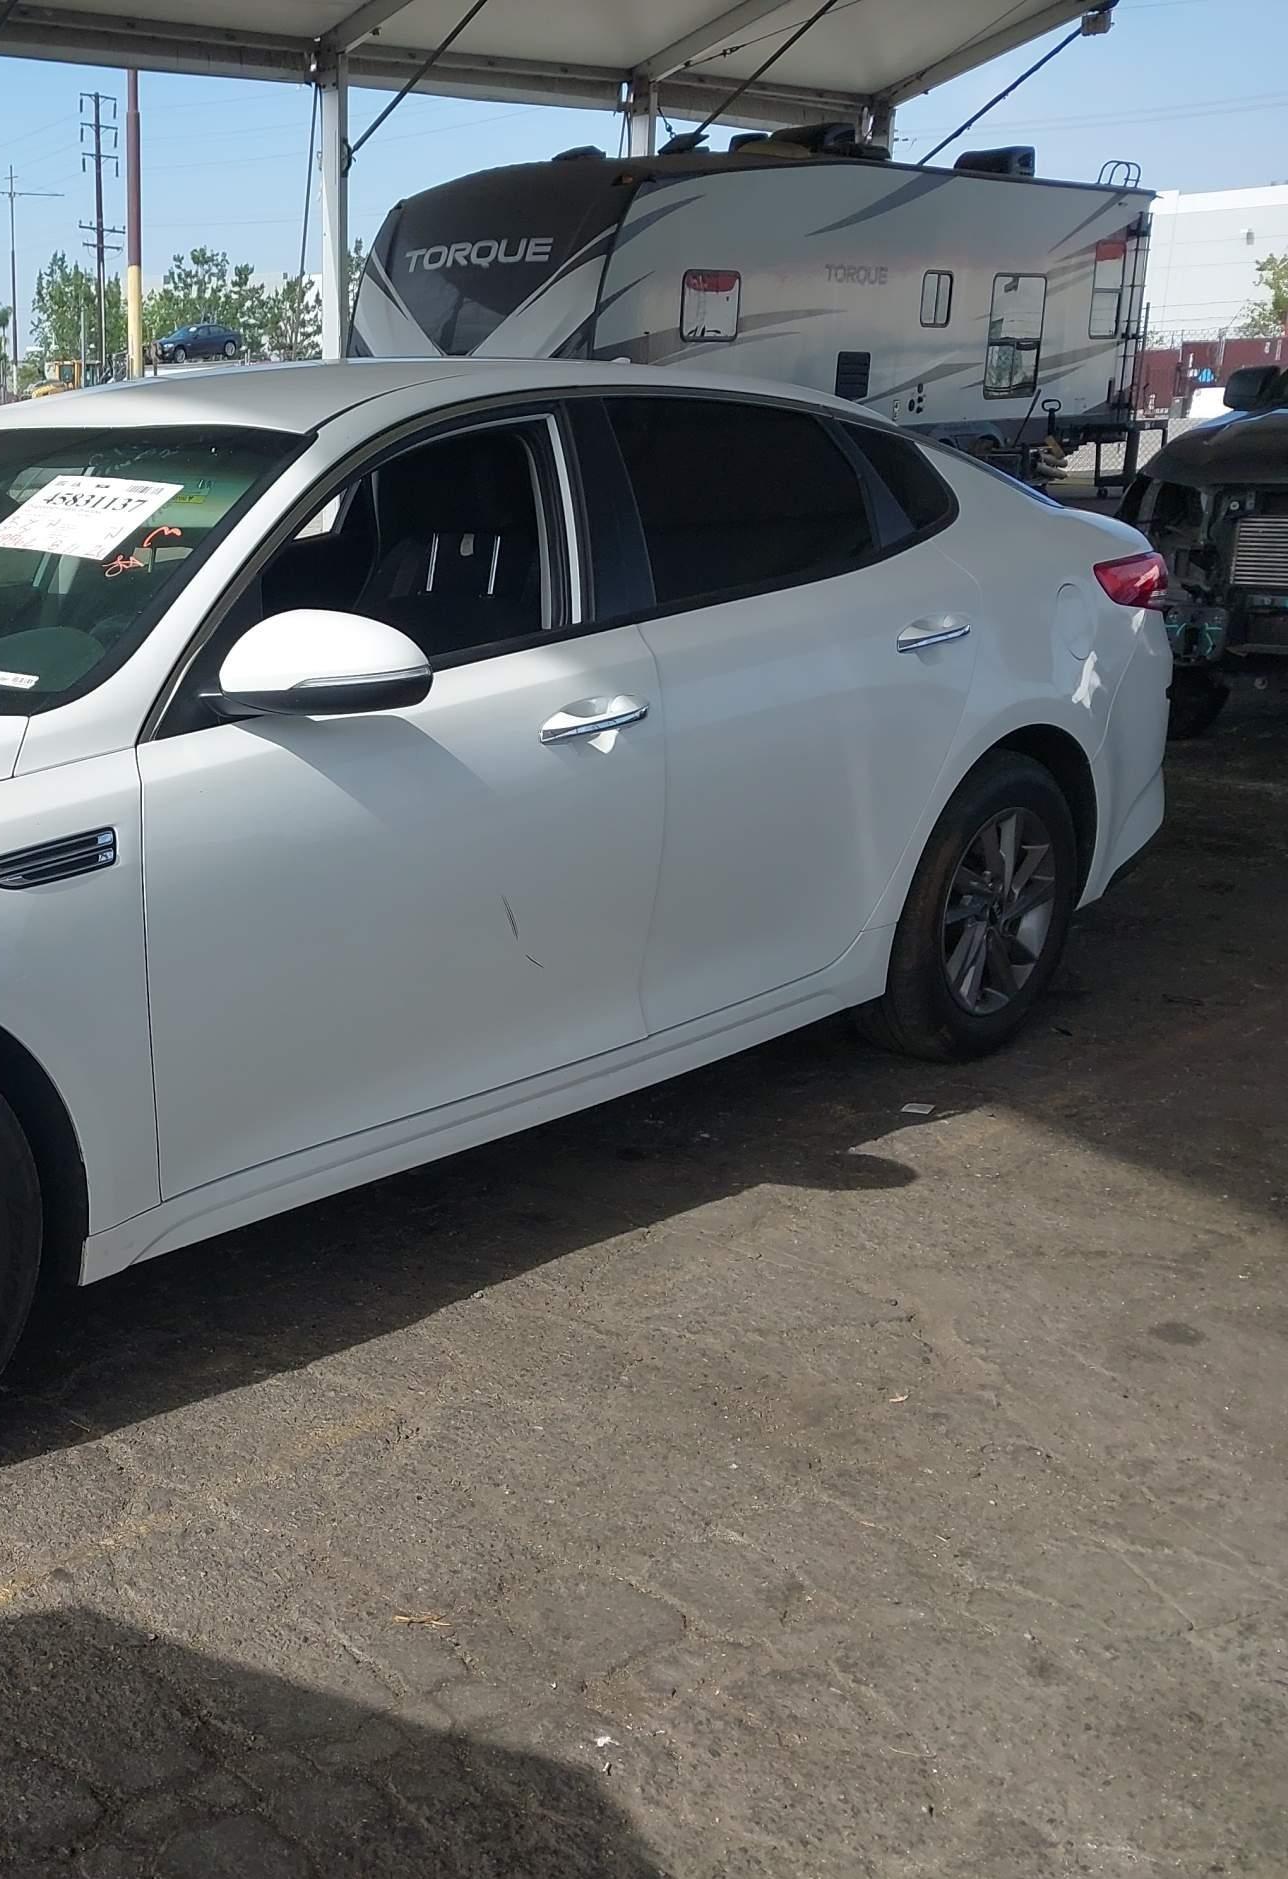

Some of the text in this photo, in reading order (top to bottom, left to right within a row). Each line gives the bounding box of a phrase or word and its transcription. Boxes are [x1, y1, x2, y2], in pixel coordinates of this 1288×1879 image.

[405, 237, 554, 272] TORQUE
[824, 263, 889, 286] TORQUE
[43, 491, 149, 513] 45831137
